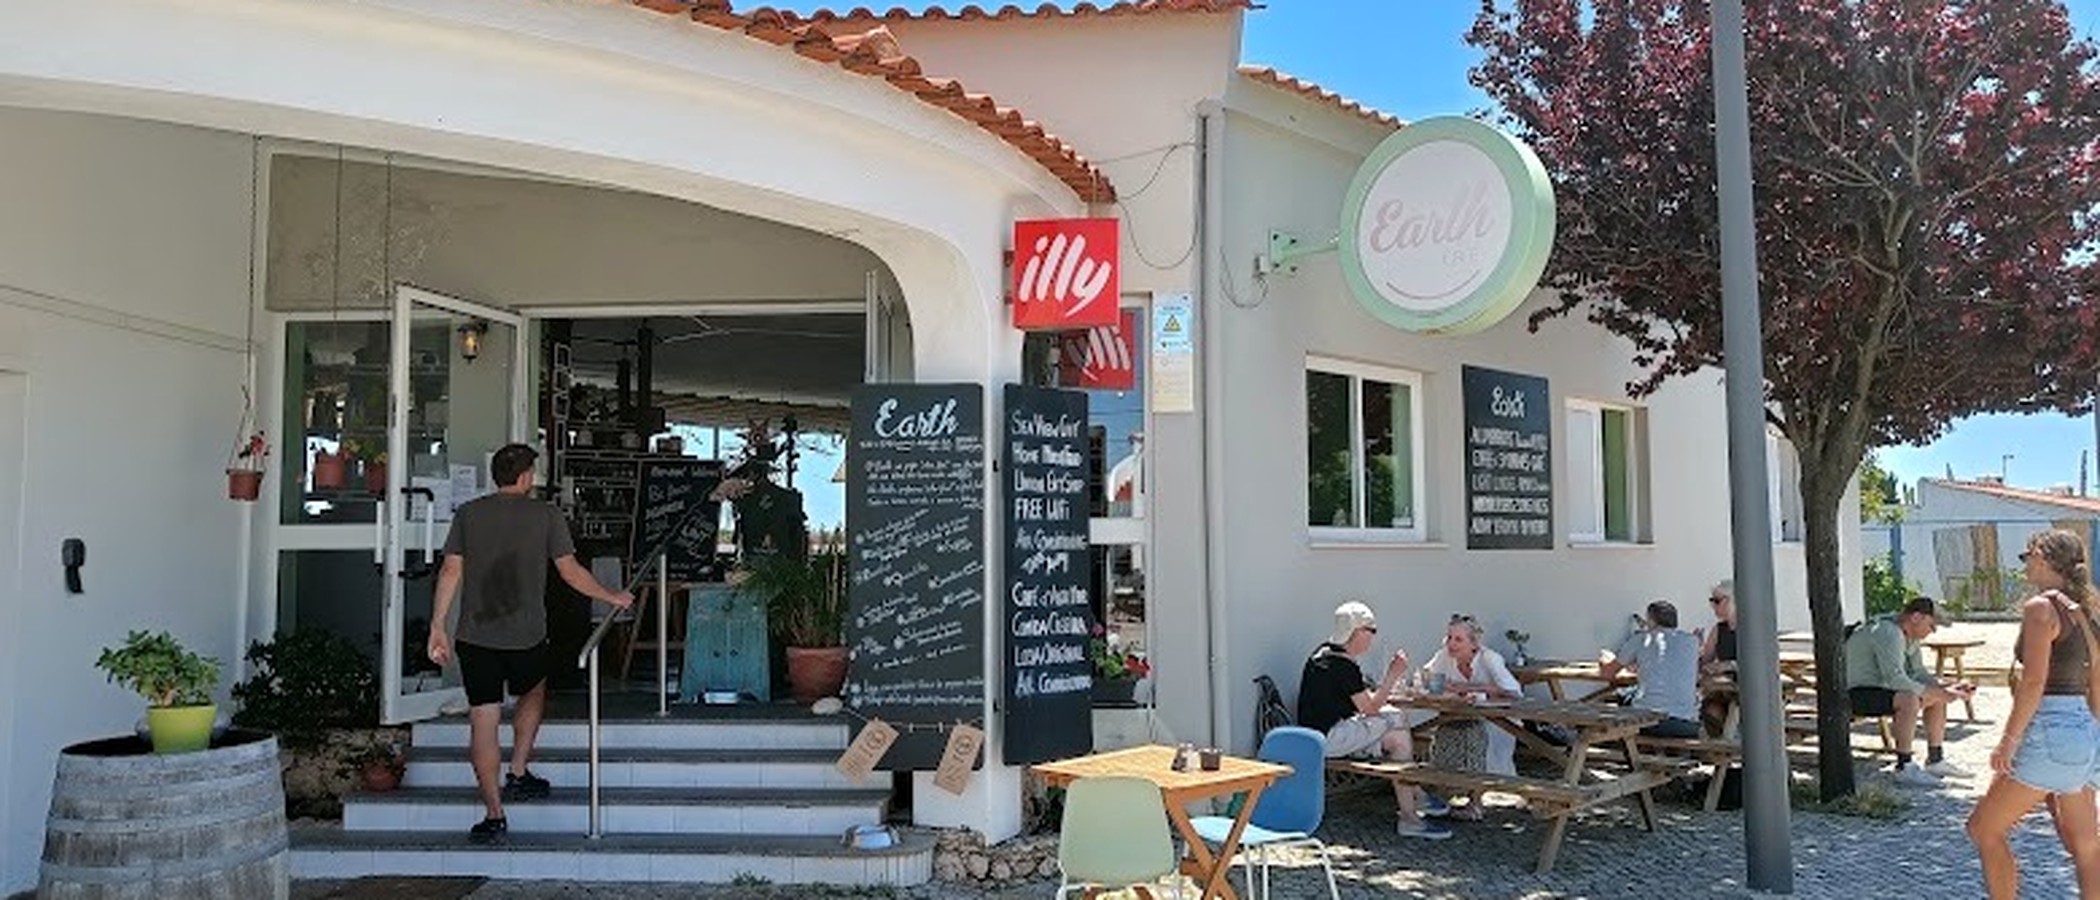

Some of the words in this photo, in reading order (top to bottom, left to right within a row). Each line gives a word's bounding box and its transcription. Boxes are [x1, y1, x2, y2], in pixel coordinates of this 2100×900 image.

[1370, 178, 1494, 253] Earth
[1018, 233, 1112, 319] illy
[875, 398, 962, 438] Earth
[1014, 497, 1043, 520] FREE
